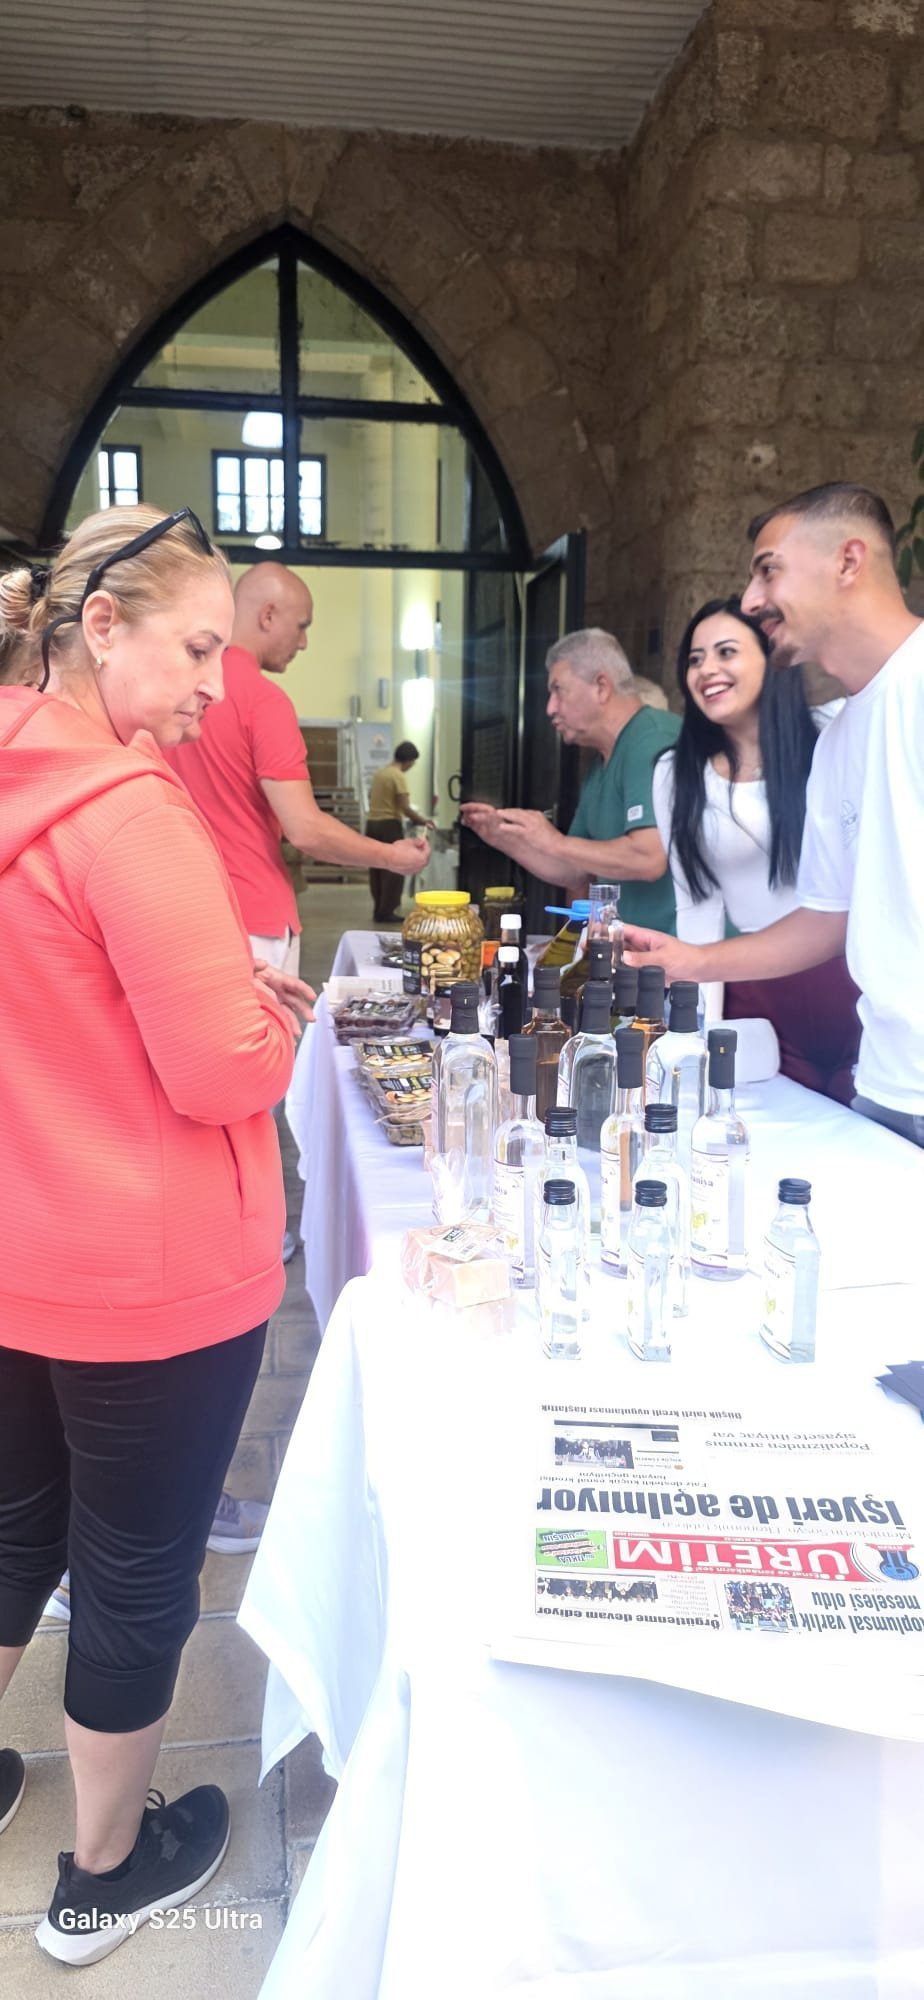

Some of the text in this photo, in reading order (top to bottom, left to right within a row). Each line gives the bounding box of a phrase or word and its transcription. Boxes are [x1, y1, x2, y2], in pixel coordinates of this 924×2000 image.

[537, 1487, 719, 1519] açılmıyor
[729, 1494, 779, 1524] de
[617, 1538, 849, 1581] ÜRETİM
[812, 1592, 921, 1612] meselesi oldu
[537, 1607, 720, 1630] Örgütlenme devam ediyor
[800, 1613, 846, 1632] varlık
